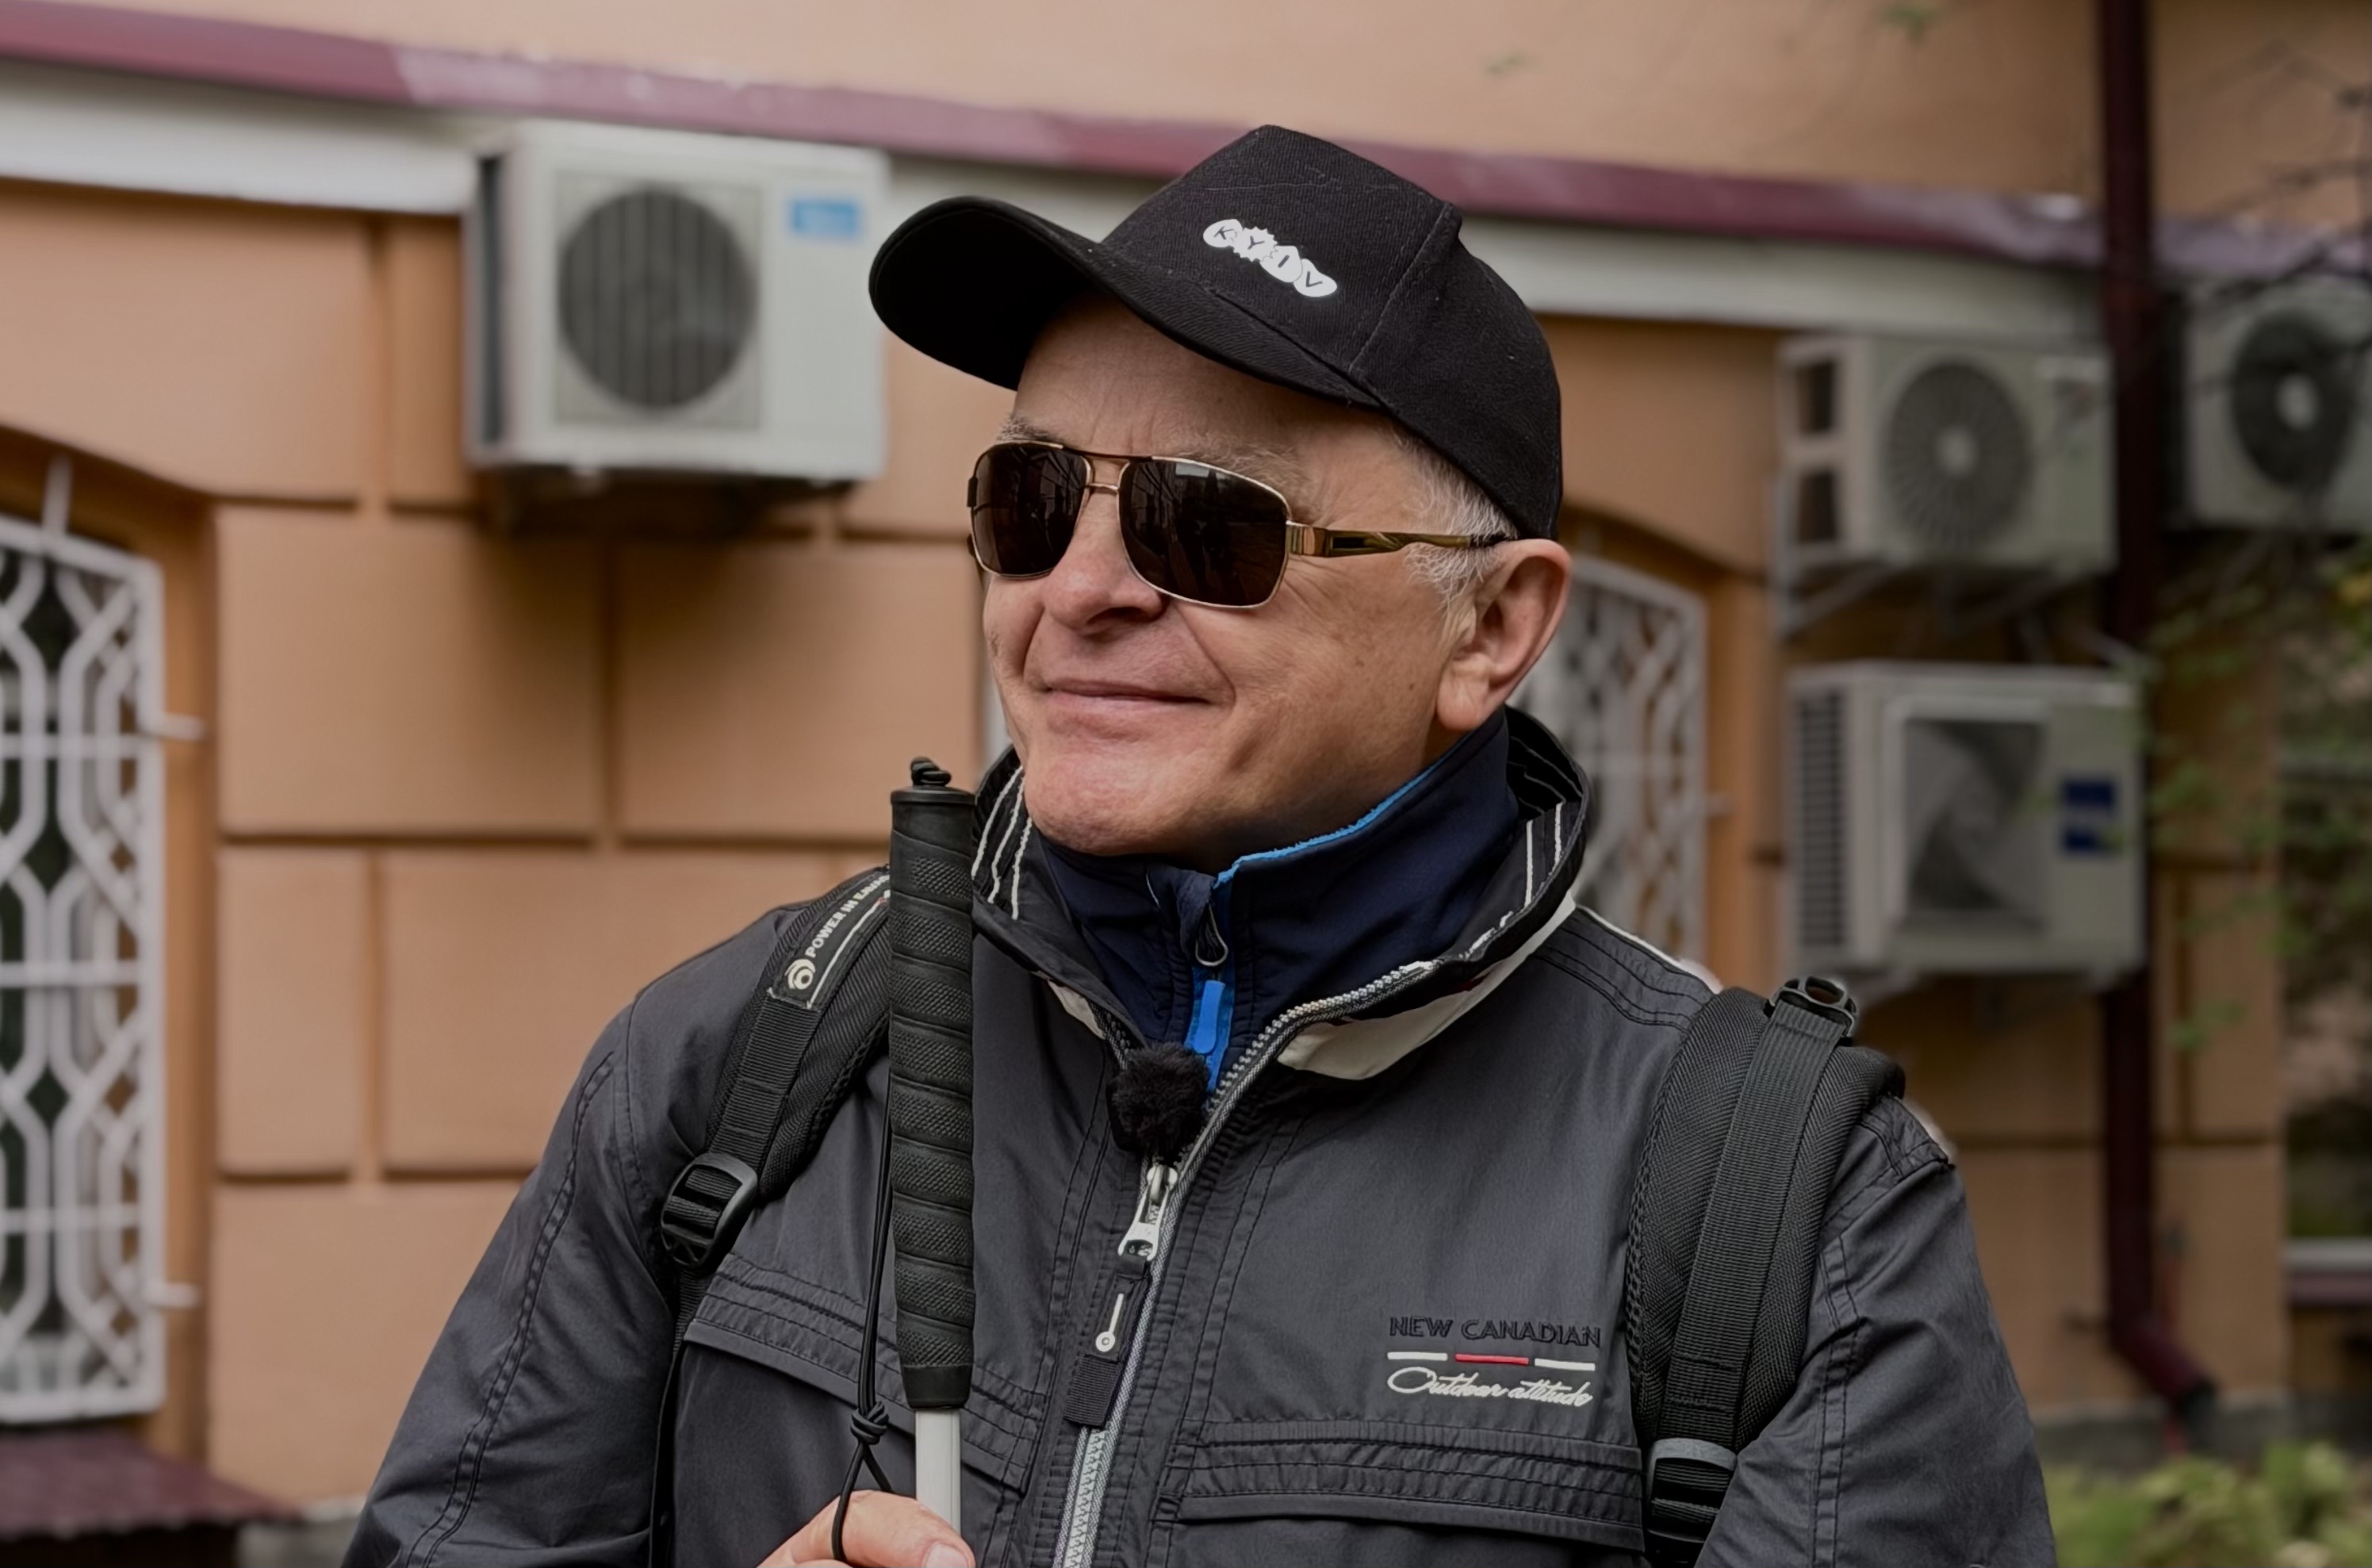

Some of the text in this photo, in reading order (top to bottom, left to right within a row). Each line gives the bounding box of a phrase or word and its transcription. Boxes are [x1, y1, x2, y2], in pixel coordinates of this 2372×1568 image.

[1213, 225, 1324, 288] KYIV
[804, 912, 846, 958] POWER
[840, 899, 859, 913] IN
[1389, 1316, 1600, 1348] NEW CANADIAN
[1388, 1367, 1592, 1407] Outdoor attitude
